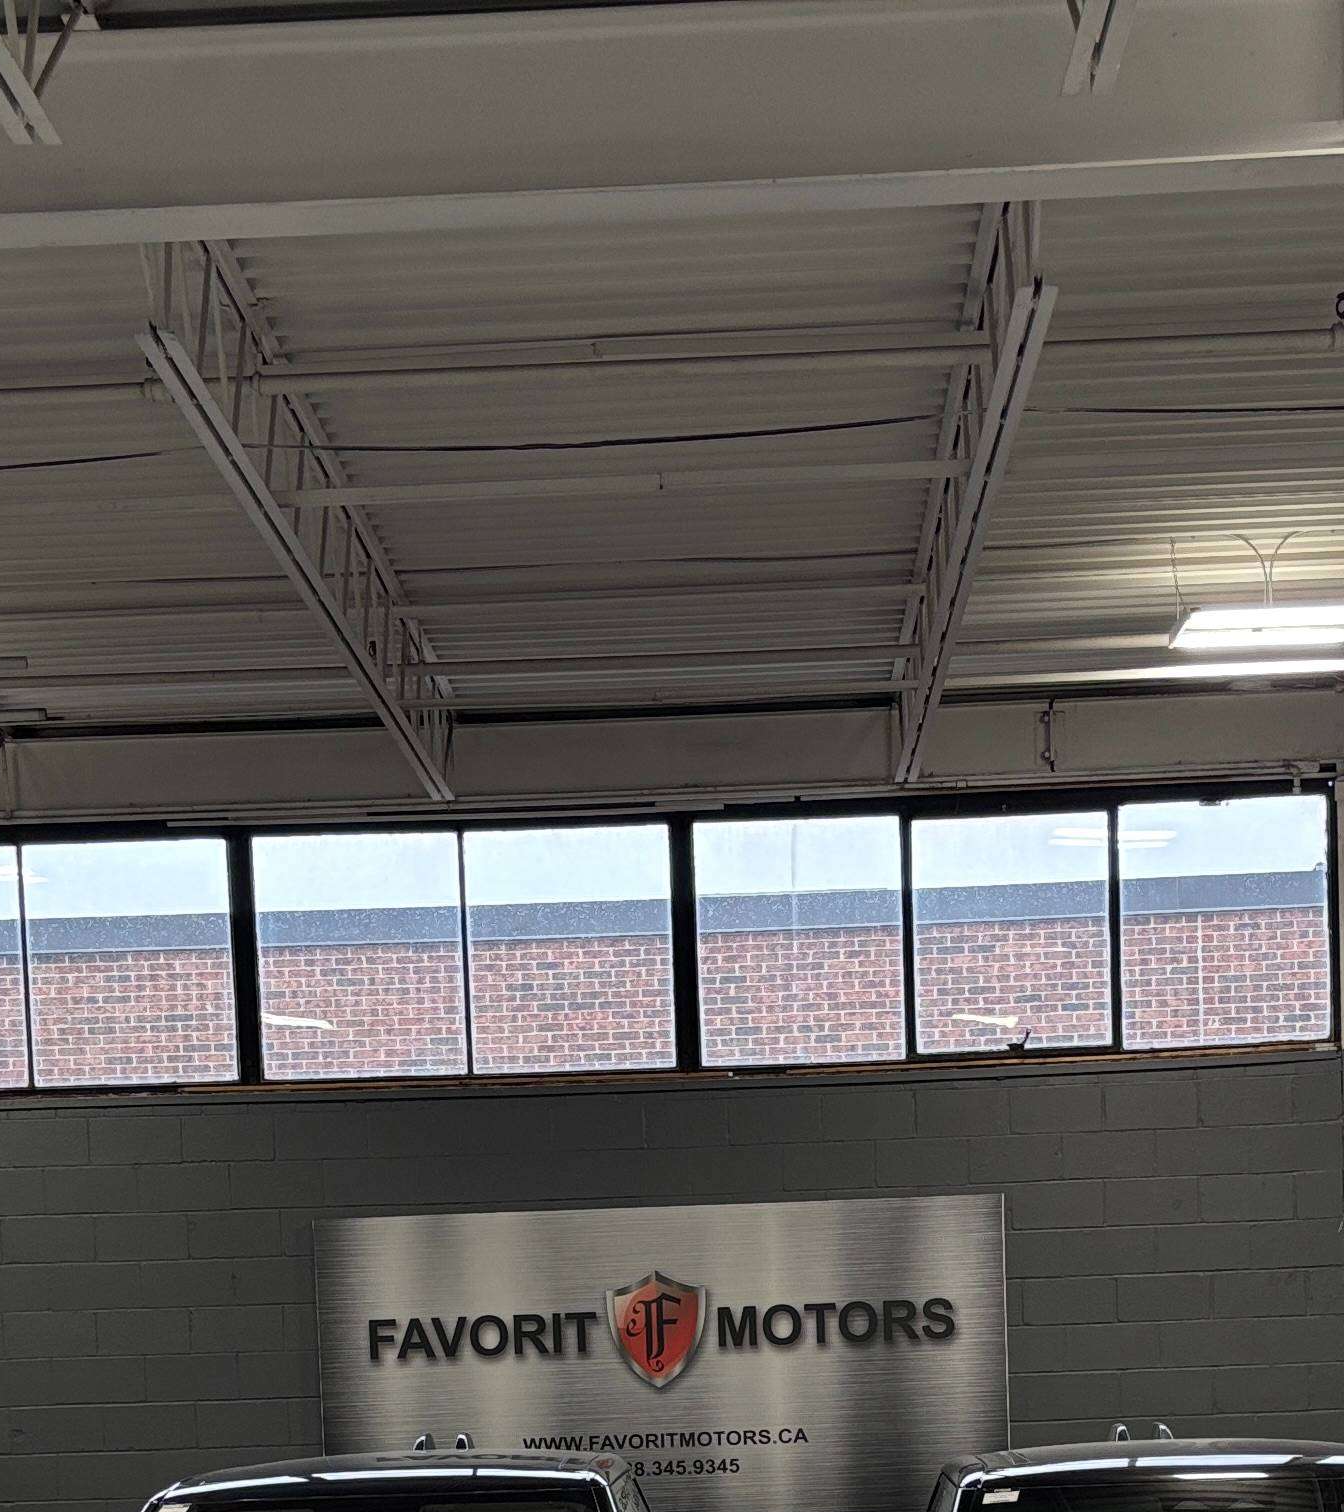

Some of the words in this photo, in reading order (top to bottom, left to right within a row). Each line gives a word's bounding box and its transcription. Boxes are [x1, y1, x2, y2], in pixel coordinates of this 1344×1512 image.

[368, 1312, 597, 1361] FAVORIT
[717, 1297, 956, 1348] MOTORS
[523, 1428, 809, 1451] WWW.FAVORITMOTORS.CA
[627, 1458, 740, 1477] 8.345.9345
